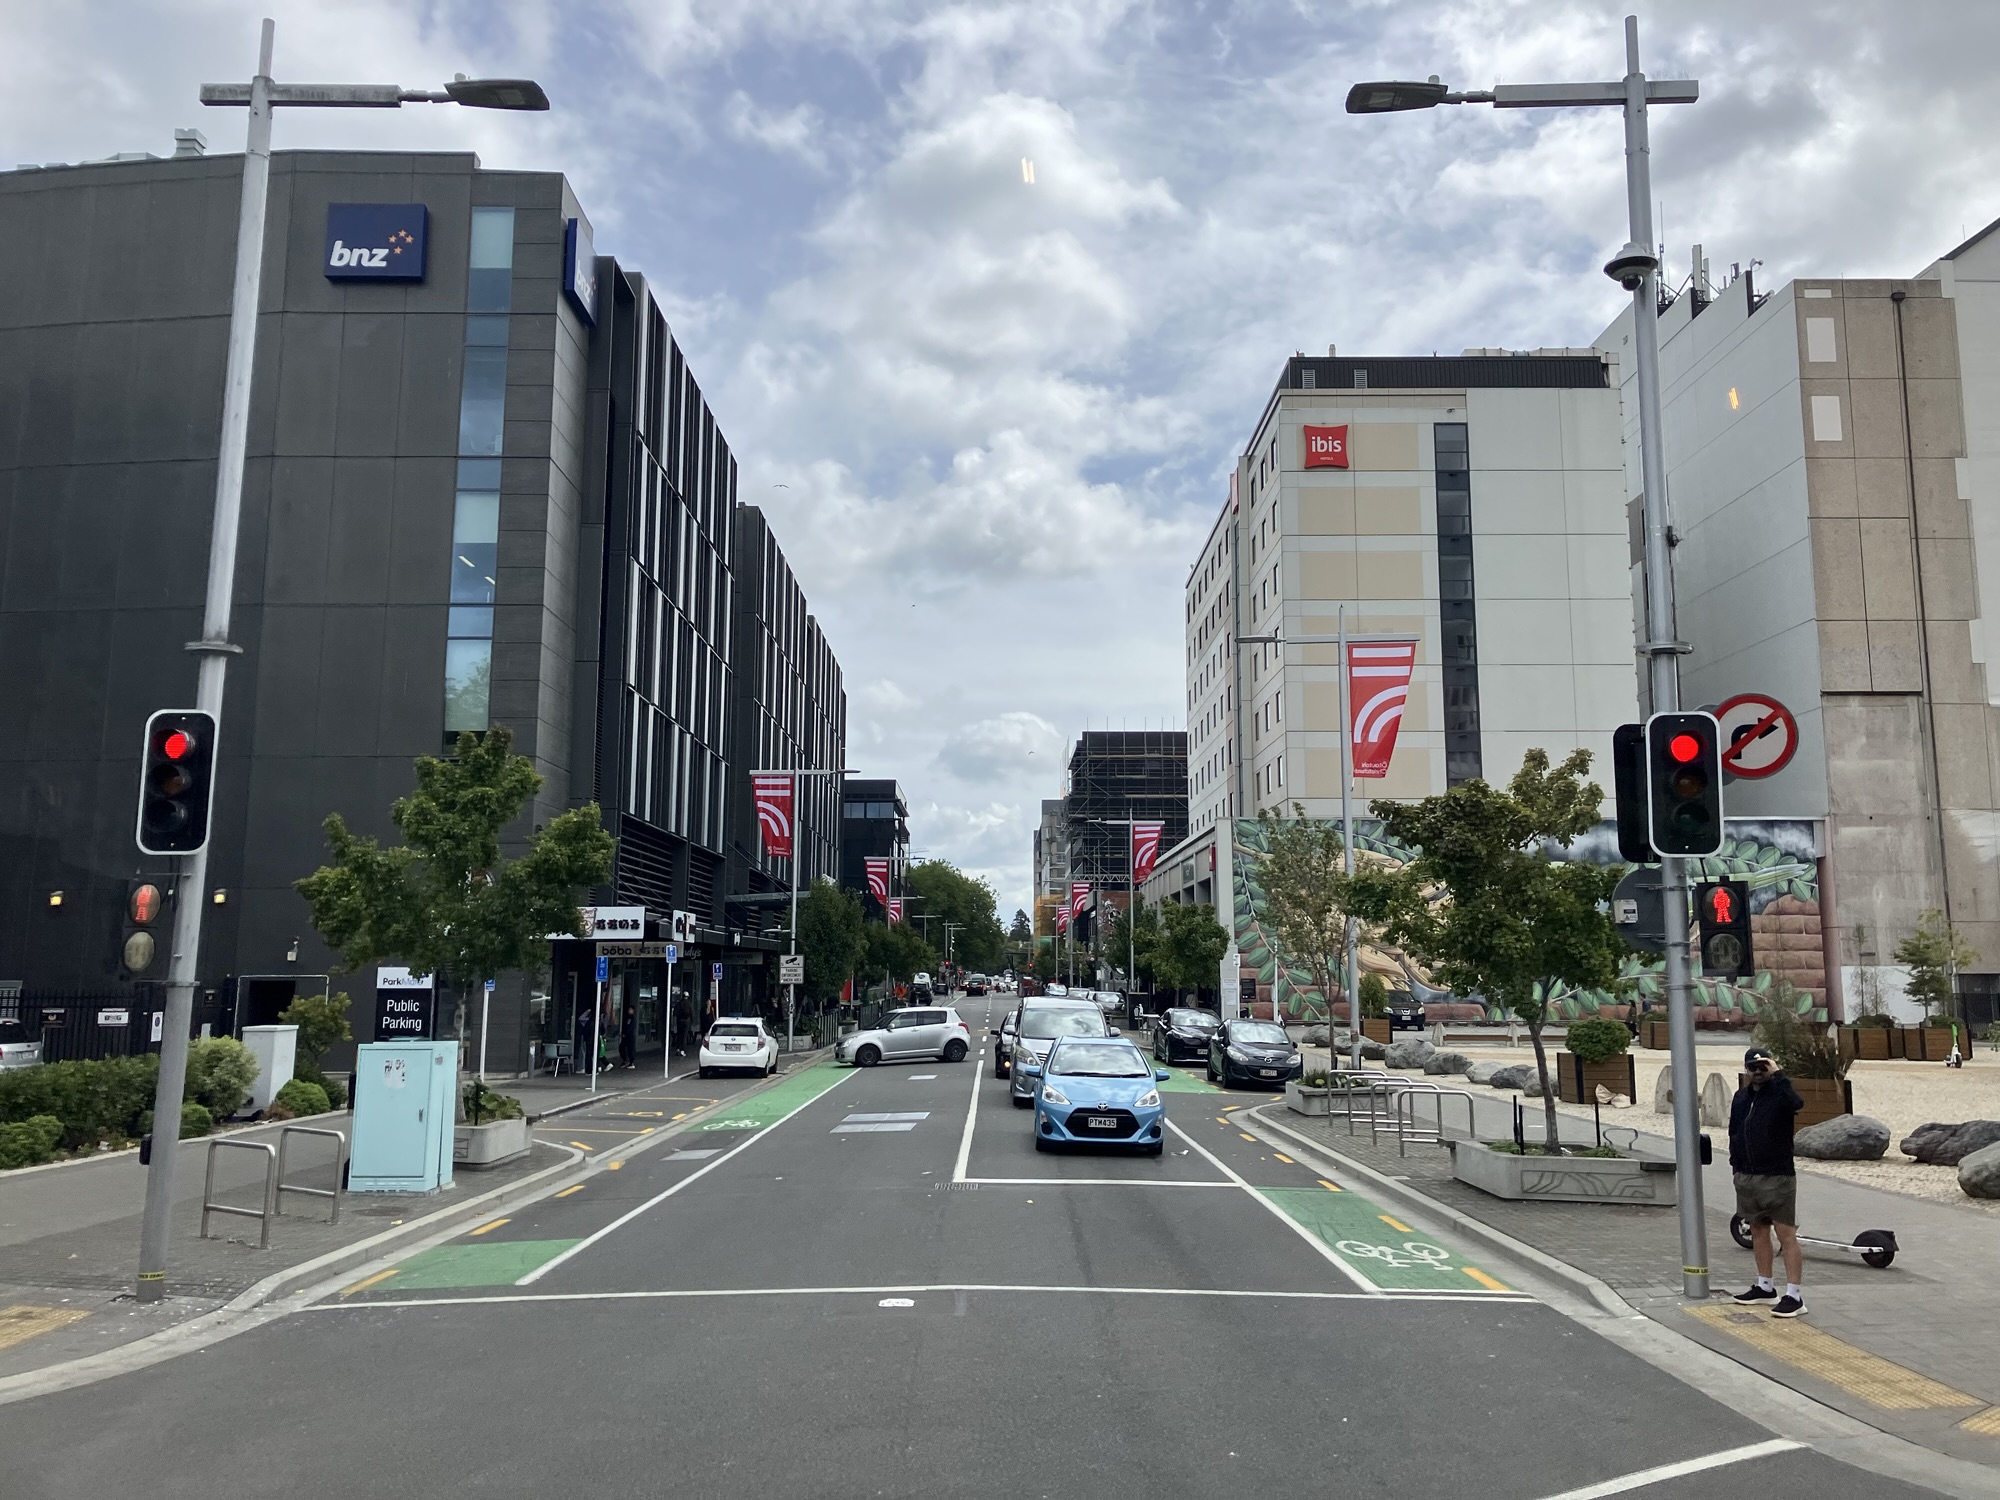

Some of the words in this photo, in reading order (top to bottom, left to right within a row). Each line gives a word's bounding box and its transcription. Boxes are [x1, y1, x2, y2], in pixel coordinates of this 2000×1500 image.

[329, 240, 390, 267] bnz
[576, 259, 591, 304] bnz
[1311, 436, 1342, 453] ibis
[602, 945, 632, 955] böba
[386, 999, 420, 1012] Public
[382, 1016, 422, 1031] Parking
